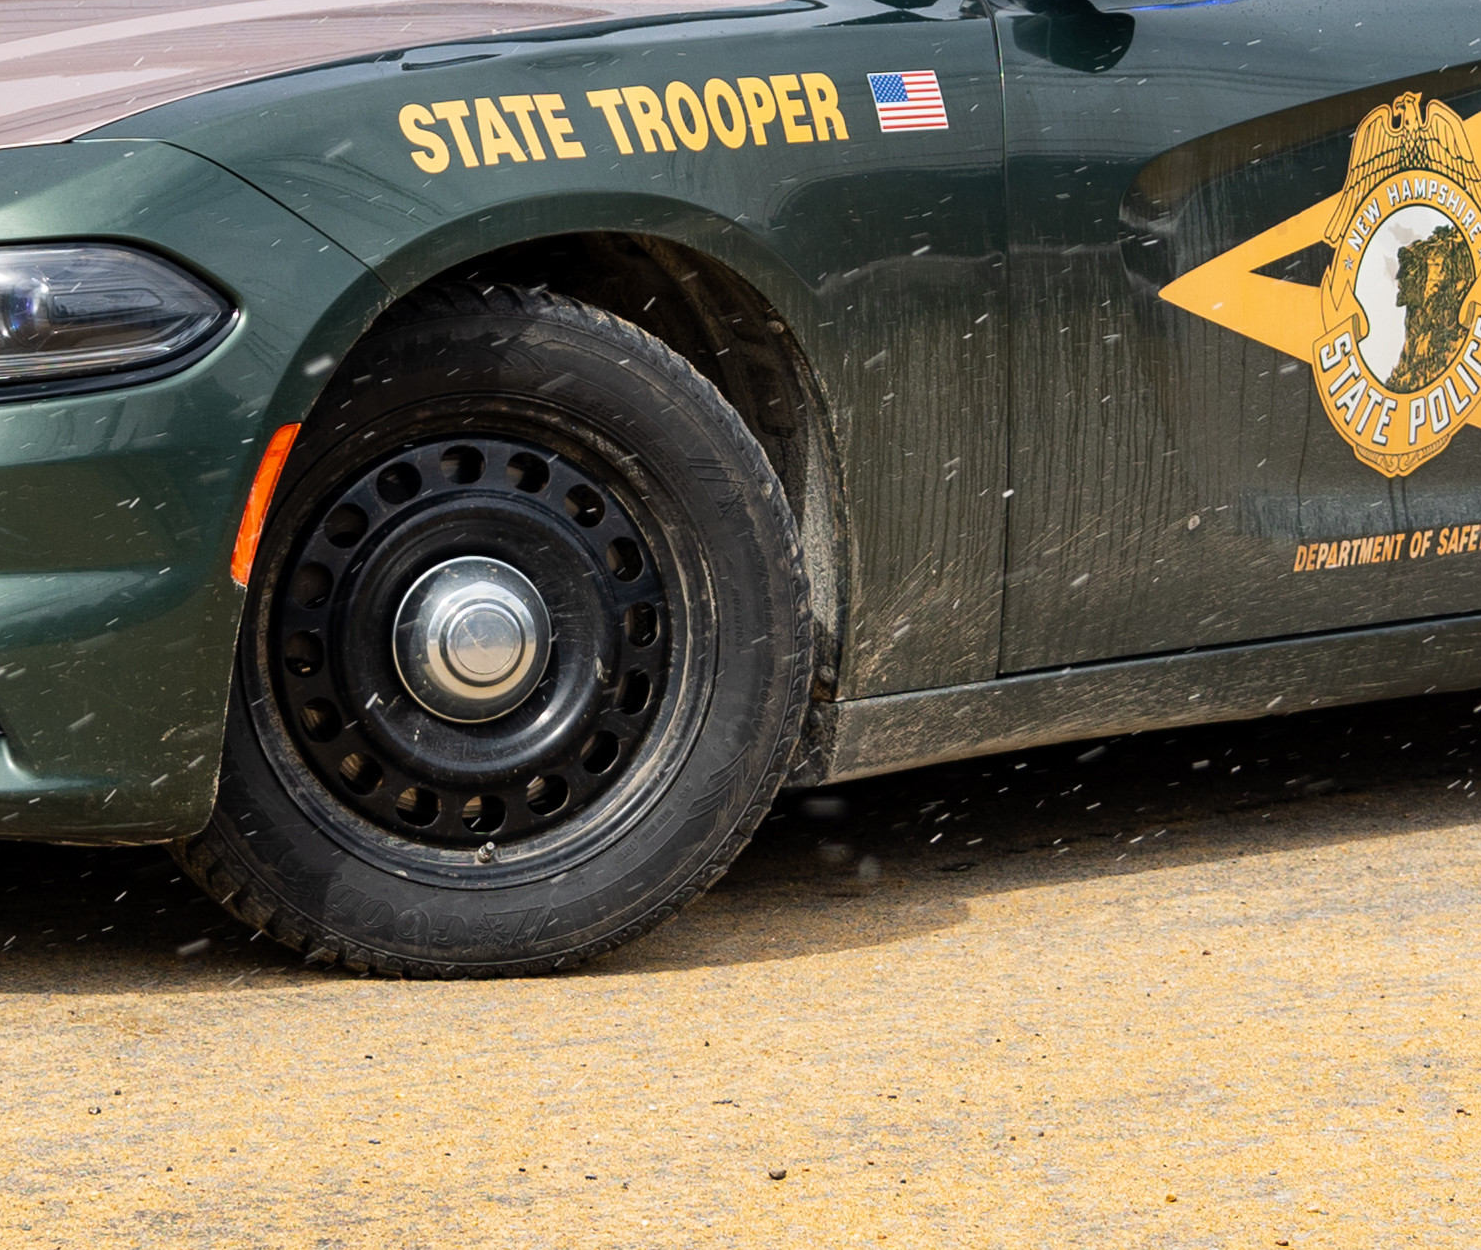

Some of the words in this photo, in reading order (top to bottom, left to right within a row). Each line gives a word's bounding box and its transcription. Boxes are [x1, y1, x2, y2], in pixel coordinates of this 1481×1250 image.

[398, 94, 586, 174] STATE
[586, 72, 849, 155] TROOPER
[1347, 197, 1381, 252] NEW
[1319, 330, 1398, 446] STATE
[1293, 533, 1406, 572] DEPARTMENT
[1409, 530, 1433, 558] OF
